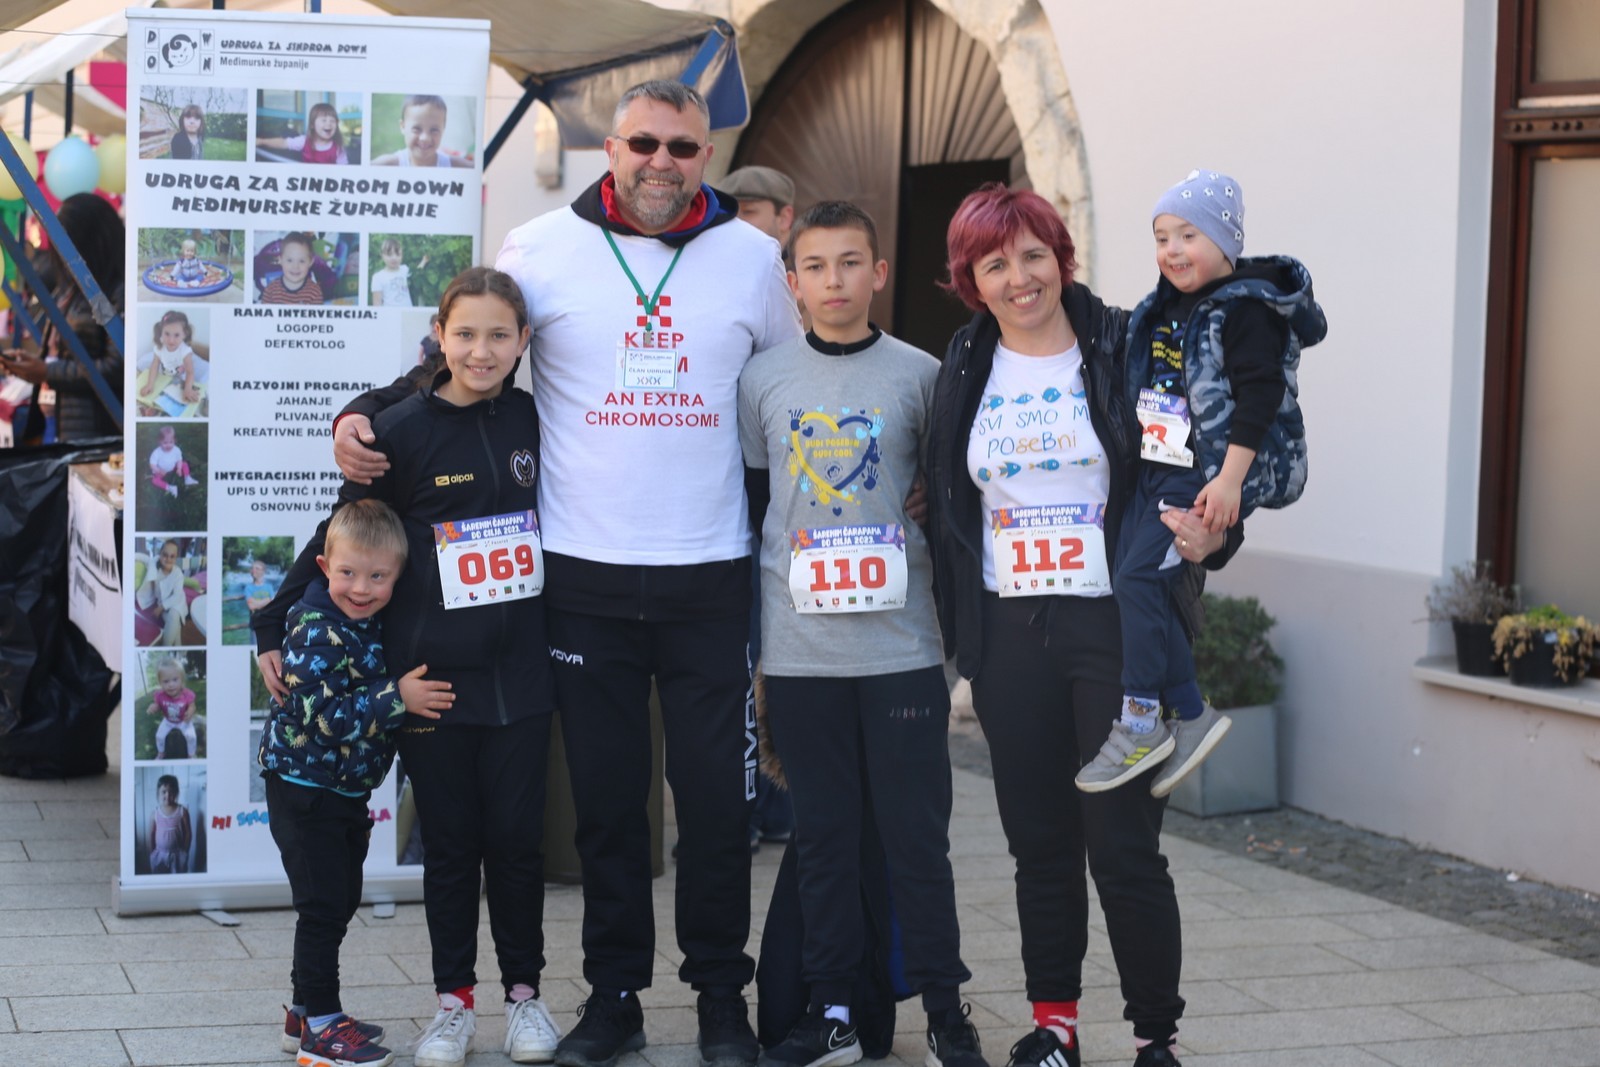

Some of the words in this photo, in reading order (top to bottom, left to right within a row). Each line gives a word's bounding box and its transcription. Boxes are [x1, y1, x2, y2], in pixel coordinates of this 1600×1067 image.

[220, 39, 264, 50] UDRUGA
[267, 41, 281, 51] ZA
[286, 42, 333, 53] SINDROM
[337, 43, 367, 54] DOWN
[273, 58, 309, 70] županije
[145, 172, 240, 191] UDRUGA
[248, 175, 279, 192] ZA
[286, 176, 389, 195] SINDROM
[396, 179, 464, 197] DOWN
[171, 196, 323, 216] MEĐIMURSKE
[328, 198, 439, 218] ŽUPANIJE
[233, 308, 273, 317] RANA
[278, 309, 378, 320] INTERVENCIJA:
[276, 324, 334, 333] LOGOPED
[264, 339, 346, 349] DEFEKTOLOG
[624, 331, 684, 348] KEEP
[232, 381, 300, 390] RAZVOJNI
[276, 397, 333, 406] JAHANJE
[604, 392, 635, 406] AN
[643, 393, 705, 407] EXTRA
[275, 412, 334, 421] PLIVANJE
[585, 411, 720, 427] CHROMOSOME
[1015, 408, 1059, 428] SMO
[233, 427, 303, 437] KREATIVNE
[214, 471, 316, 481] INTEGRACIJSKI
[227, 487, 256, 496] UPIS
[260, 487, 268, 496] U
[272, 484, 309, 496] VRTIĆ
[251, 502, 311, 512] OSNOVNU
[1011, 508, 1041, 519] ŠARENIM
[1041, 506, 1082, 518] ČARAPAMA
[461, 521, 492, 533] ŠARENIM
[492, 515, 525, 528] ČARAPAMA
[471, 530, 482, 539] DO
[813, 529, 843, 540] ŠARENIM
[842, 526, 881, 538] ČARAPAMA
[1012, 537, 1085, 573] 112
[457, 544, 535, 585] 069
[810, 556, 887, 592] 110
[212, 815, 231, 830] MI
